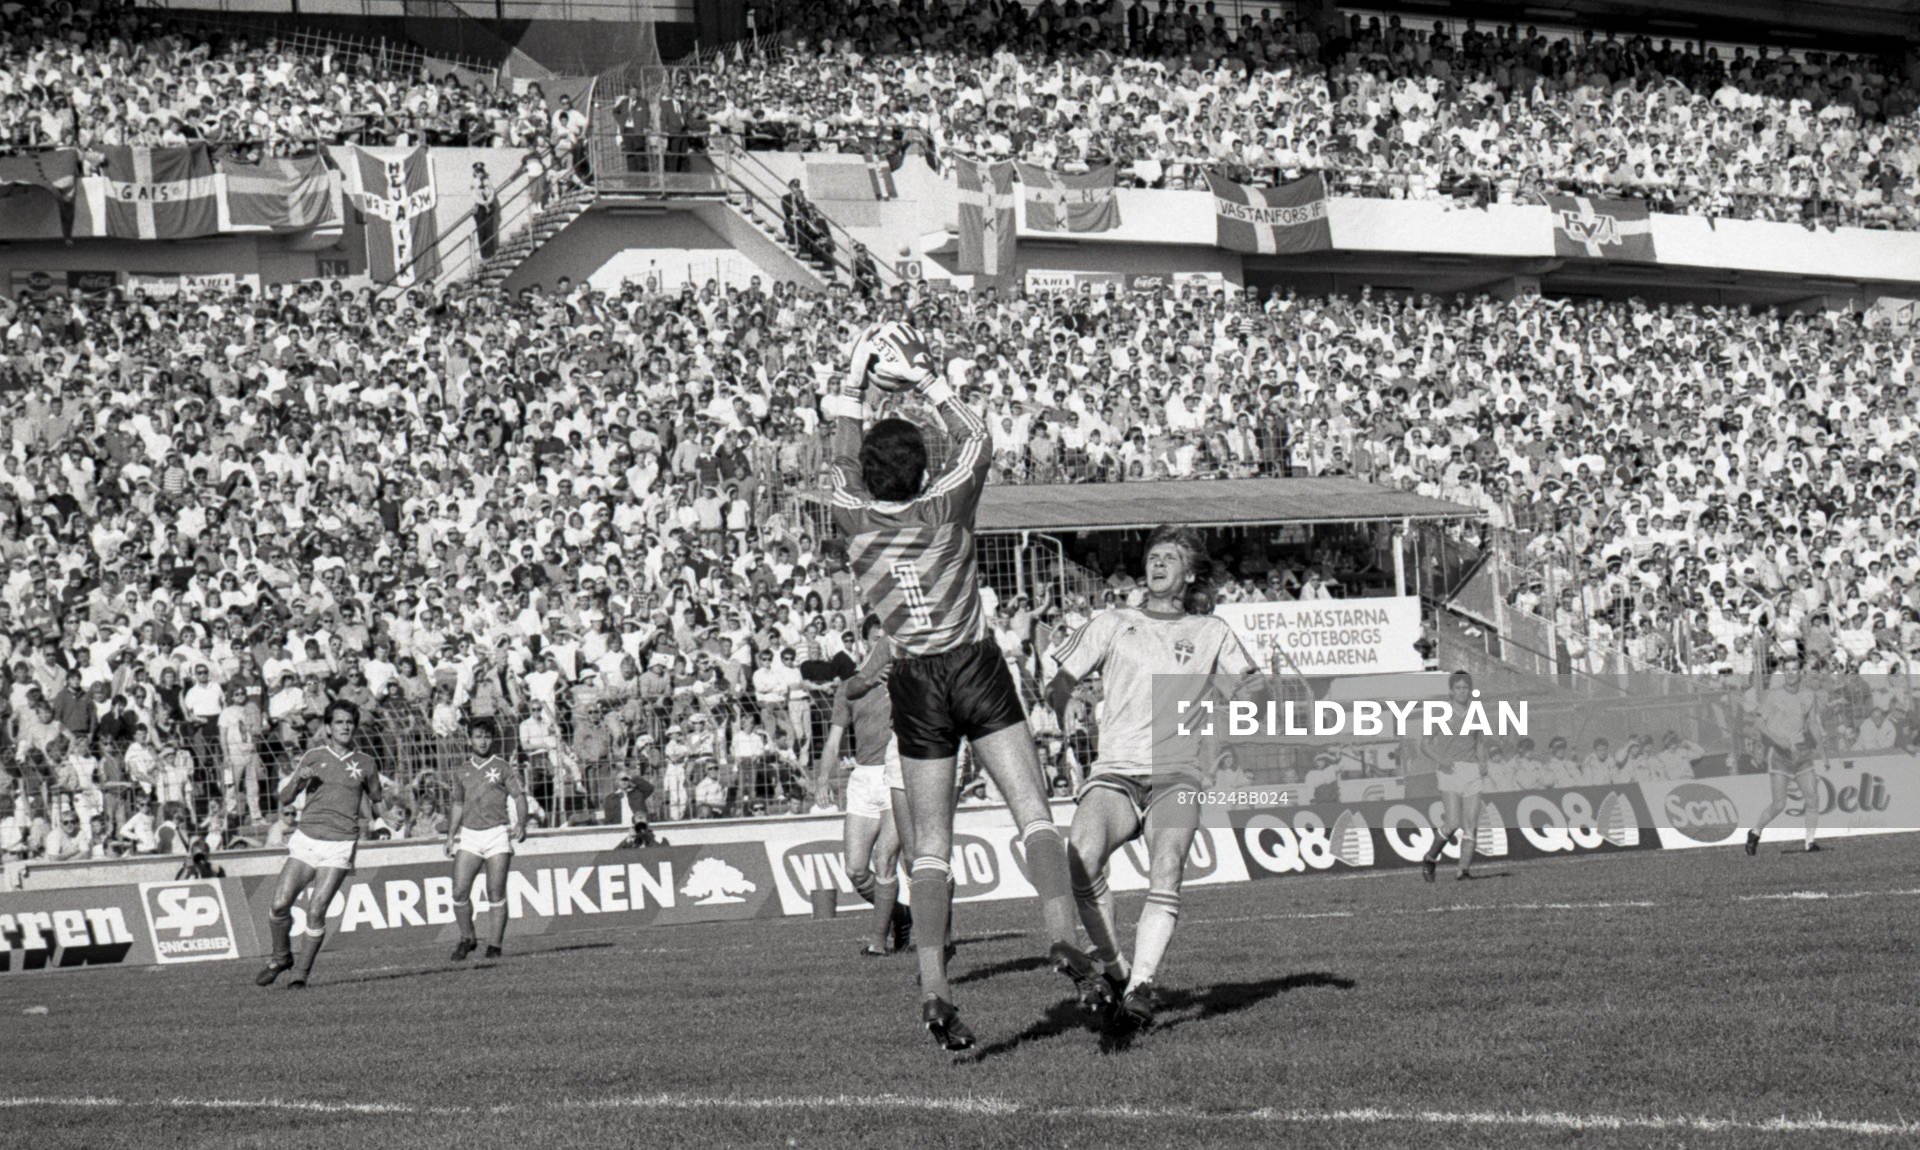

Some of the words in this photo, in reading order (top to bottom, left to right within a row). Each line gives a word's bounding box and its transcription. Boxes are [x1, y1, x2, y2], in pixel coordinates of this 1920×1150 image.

[121, 185, 168, 200] GAIS
[1309, 202, 1322, 217] IF
[890, 560, 933, 630] 1
[1243, 608, 1390, 631] UEFA-MÄSTARNA
[1287, 628, 1383, 649] GÖTEBORGS
[1516, 792, 1603, 853] Q8
[1664, 795, 1738, 827] Scan
[1244, 811, 1337, 873] Q8
[159, 937, 230, 954] SNICKERIER
